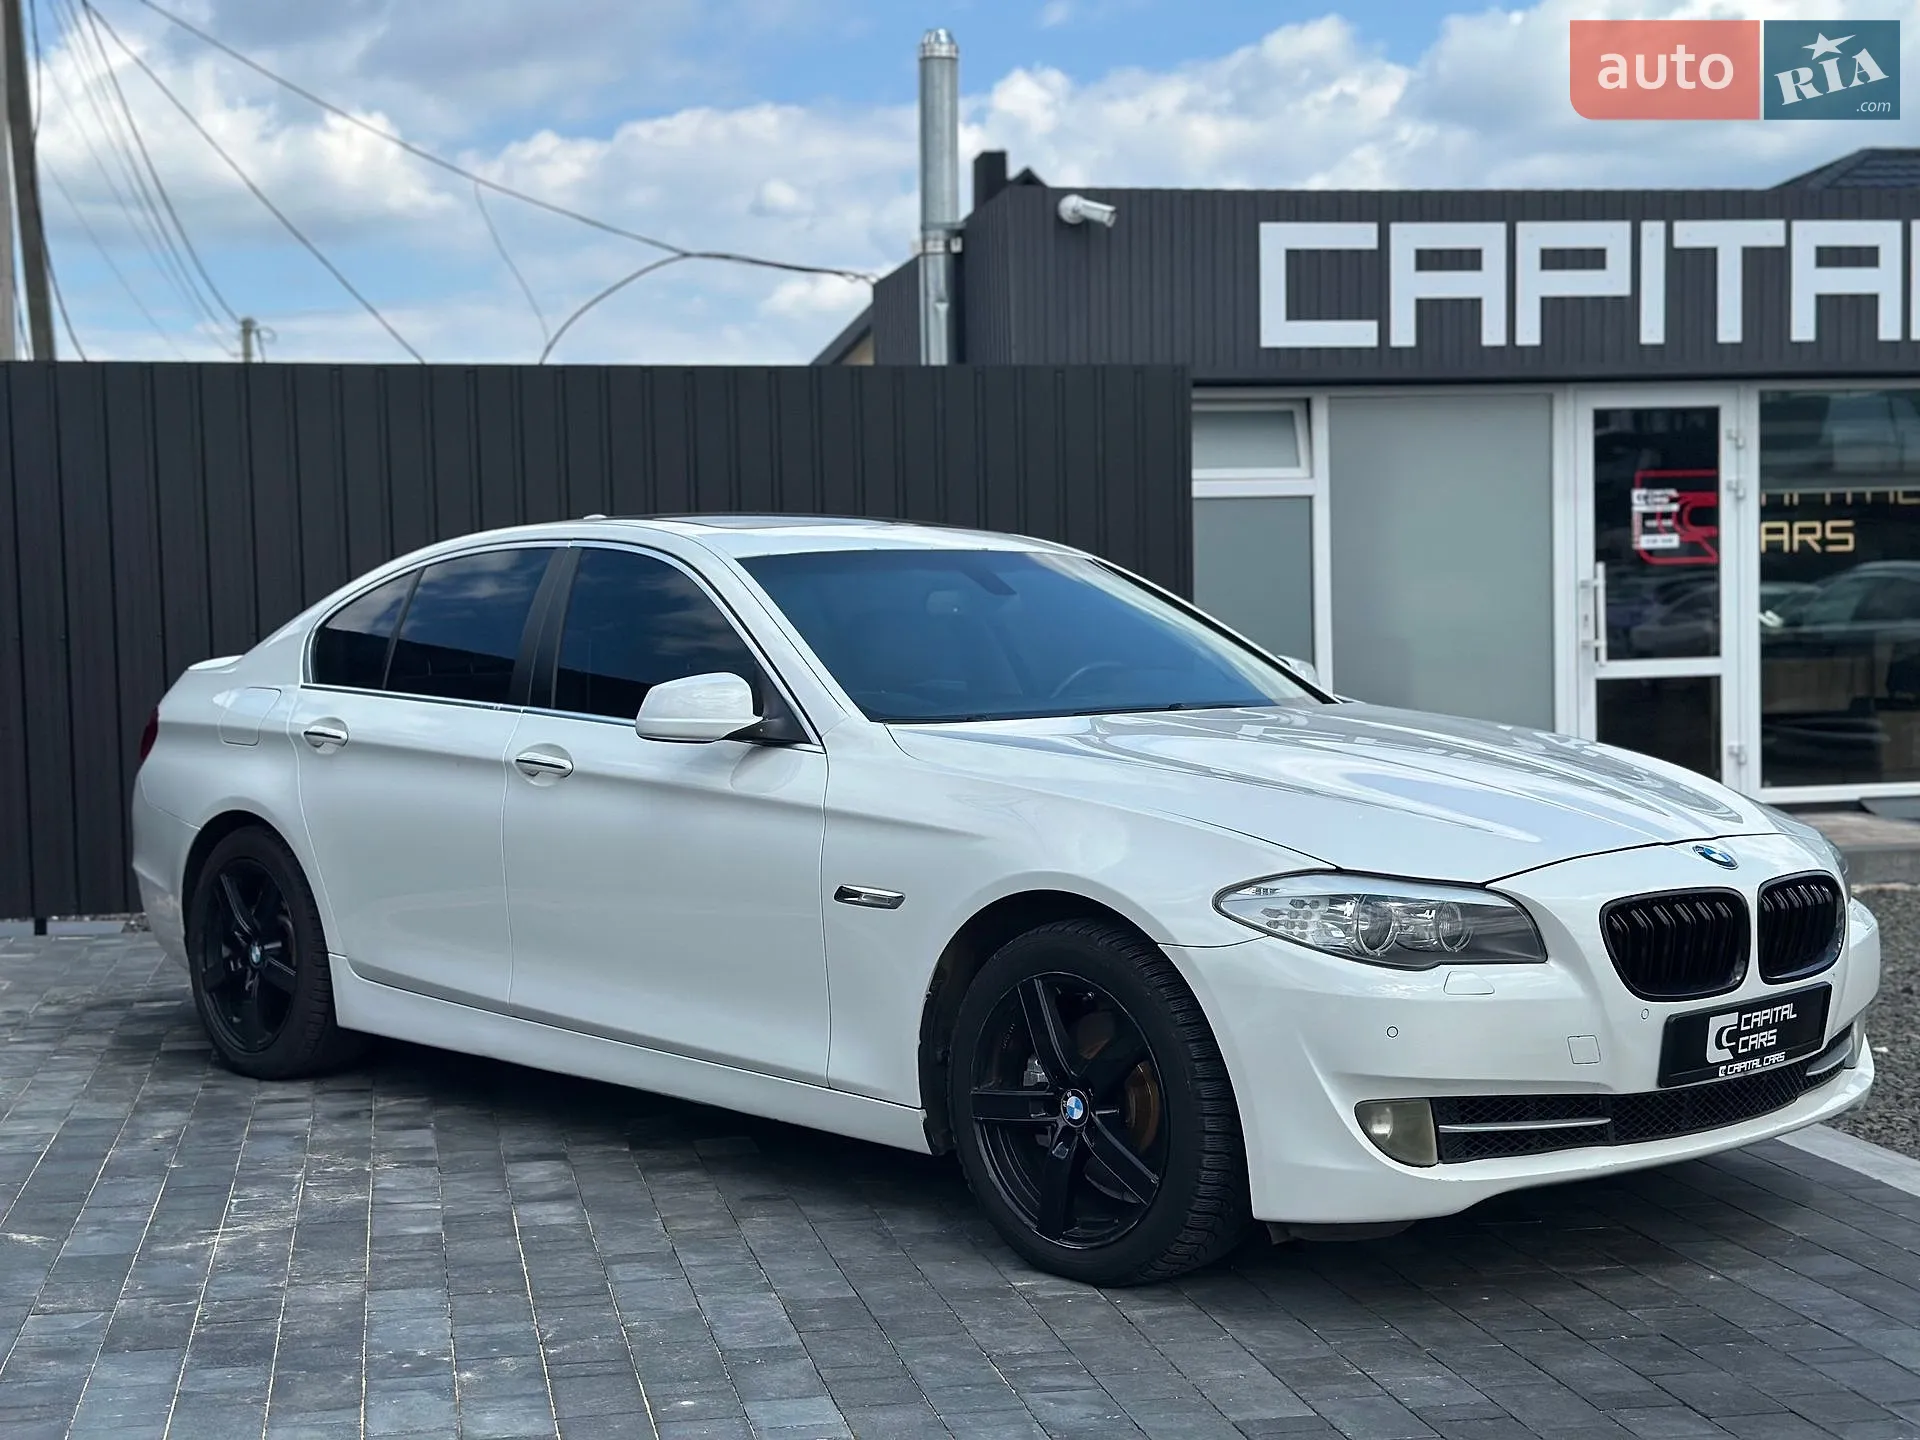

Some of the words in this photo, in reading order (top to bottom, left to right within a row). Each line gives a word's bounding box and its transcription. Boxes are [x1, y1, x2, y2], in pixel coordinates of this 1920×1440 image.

[1259, 220, 1920, 347] CAPITA
[1760, 520, 1855, 553] ARS
[1740, 1002, 1797, 1031] CAPITAL
[1738, 1028, 1777, 1054] CARS
[1727, 1058, 1762, 1075] CAPITAL
[1763, 1051, 1786, 1066] CARS
